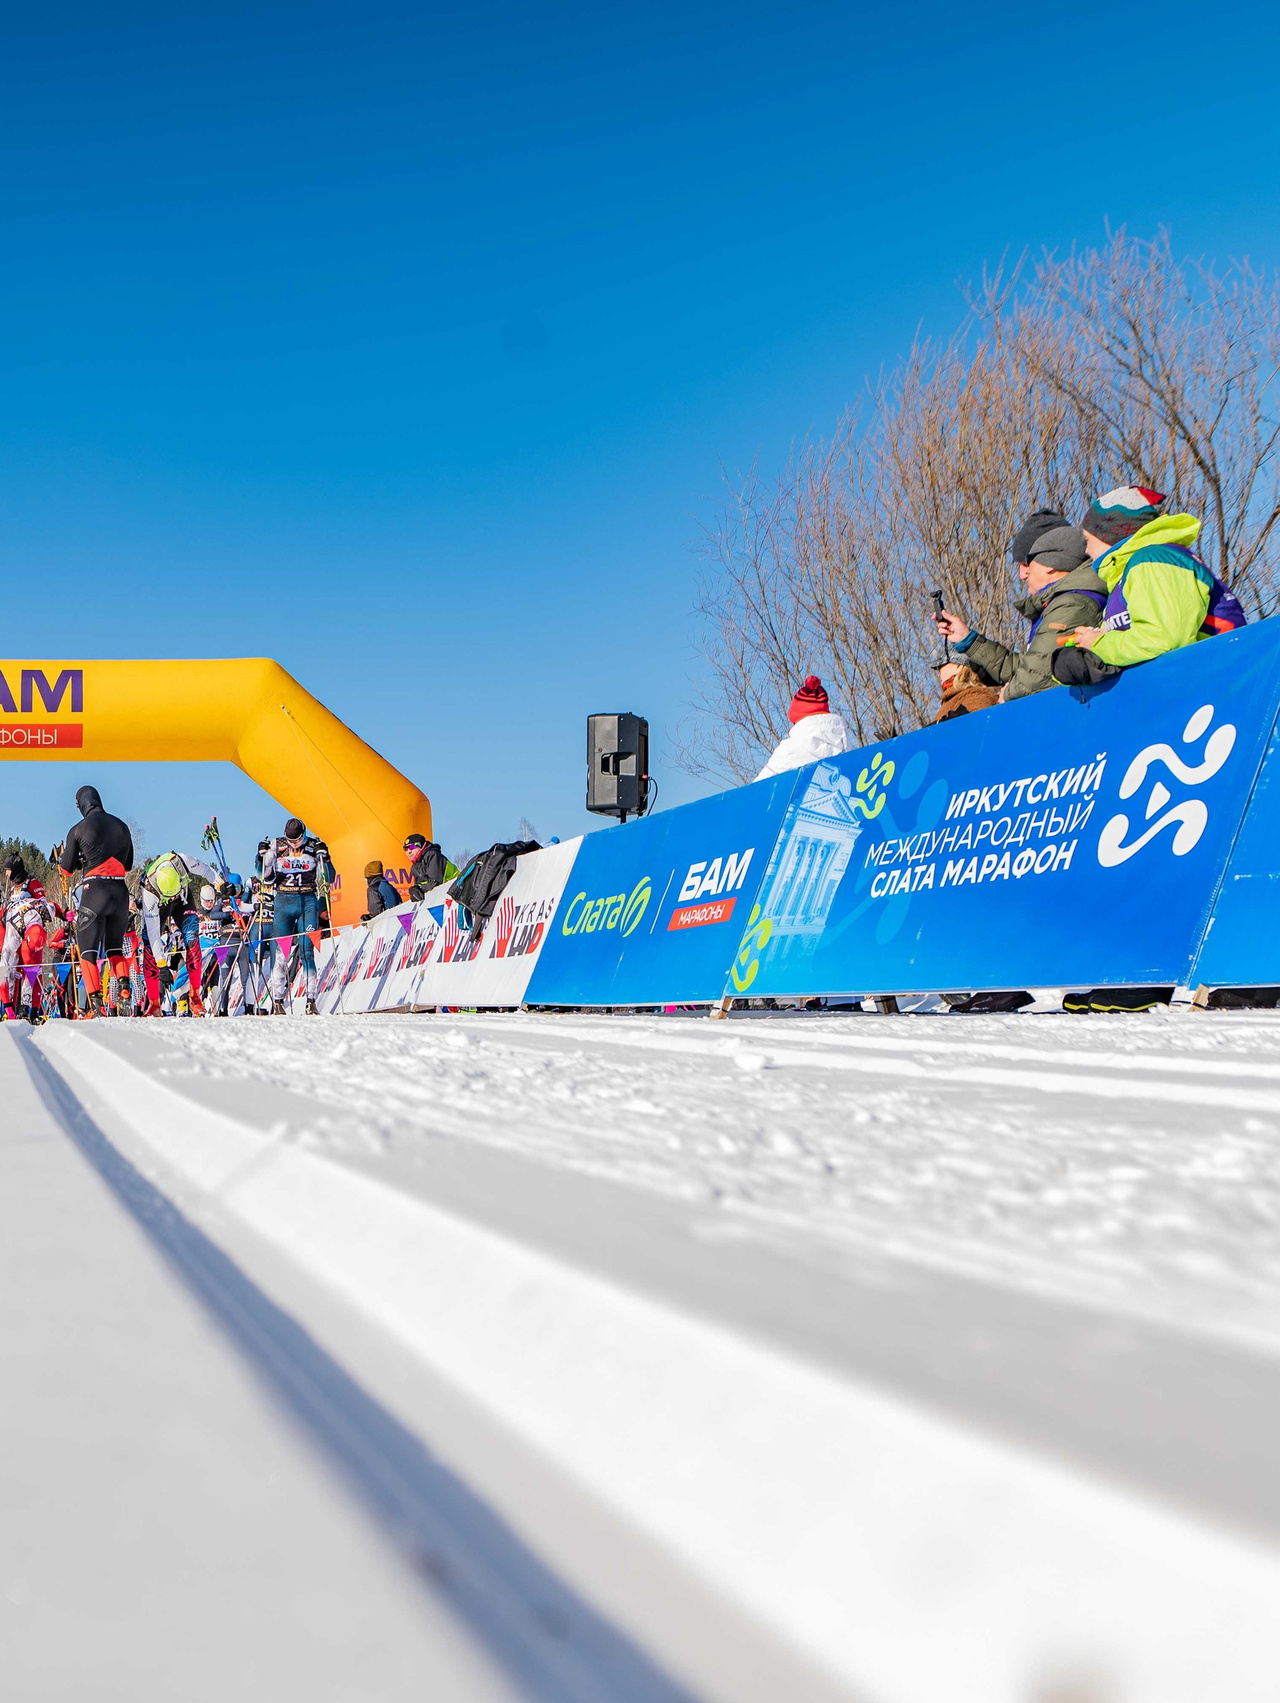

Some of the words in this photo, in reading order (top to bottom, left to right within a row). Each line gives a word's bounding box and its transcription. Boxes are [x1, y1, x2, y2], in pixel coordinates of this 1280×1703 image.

[944, 751, 1108, 821] ИРКУТСКИЙ
[863, 793, 1096, 869] МЕЖДУНАРОДНЫЙ
[285, 873, 303, 887] 21
[677, 847, 756, 903] БАМ
[869, 863, 936, 899] СЛАТА
[939, 838, 1079, 888] МАРАФОН
[519, 897, 555, 924] KRAS
[562, 891, 627, 937] Слата
[677, 903, 726, 926] МАРАФОНЫ
[406, 940, 434, 969] LAND
[507, 922, 545, 958] LAND
